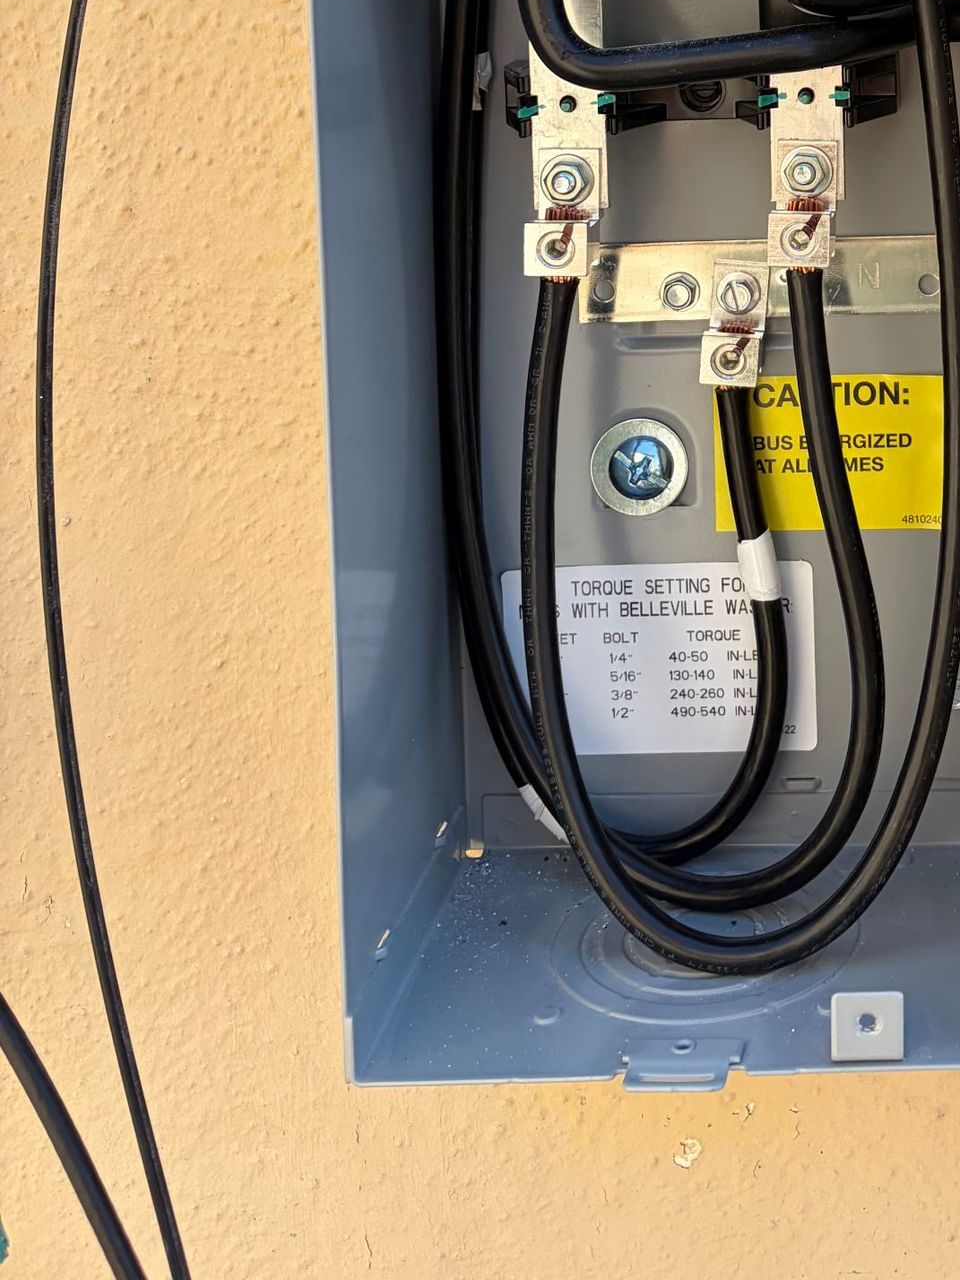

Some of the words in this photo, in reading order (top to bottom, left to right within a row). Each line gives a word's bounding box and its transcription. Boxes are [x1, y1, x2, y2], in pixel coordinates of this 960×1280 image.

[857, 262, 880, 290] N
[753, 381, 910, 408] CATION:
[753, 435, 793, 451] BUS
[799, 433, 912, 451] ERGIZED
[755, 459, 776, 474] AT
[571, 579, 633, 596] TORQUE
[644, 577, 711, 595] SETTING
[571, 602, 609, 619] WITH
[619, 599, 714, 618] BELLEVILLE
[603, 631, 639, 644] BOLT
[686, 629, 741, 642] TORQUE
[668, 650, 708, 663] 40-50
[669, 669, 715, 681] 130-140
[733, 668, 757, 680] IN-L
[669, 687, 725, 700] 240-260
[733, 687, 758, 698] IN-L
[670, 705, 726, 717] 490-540
[735, 705, 756, 716] IN-L
